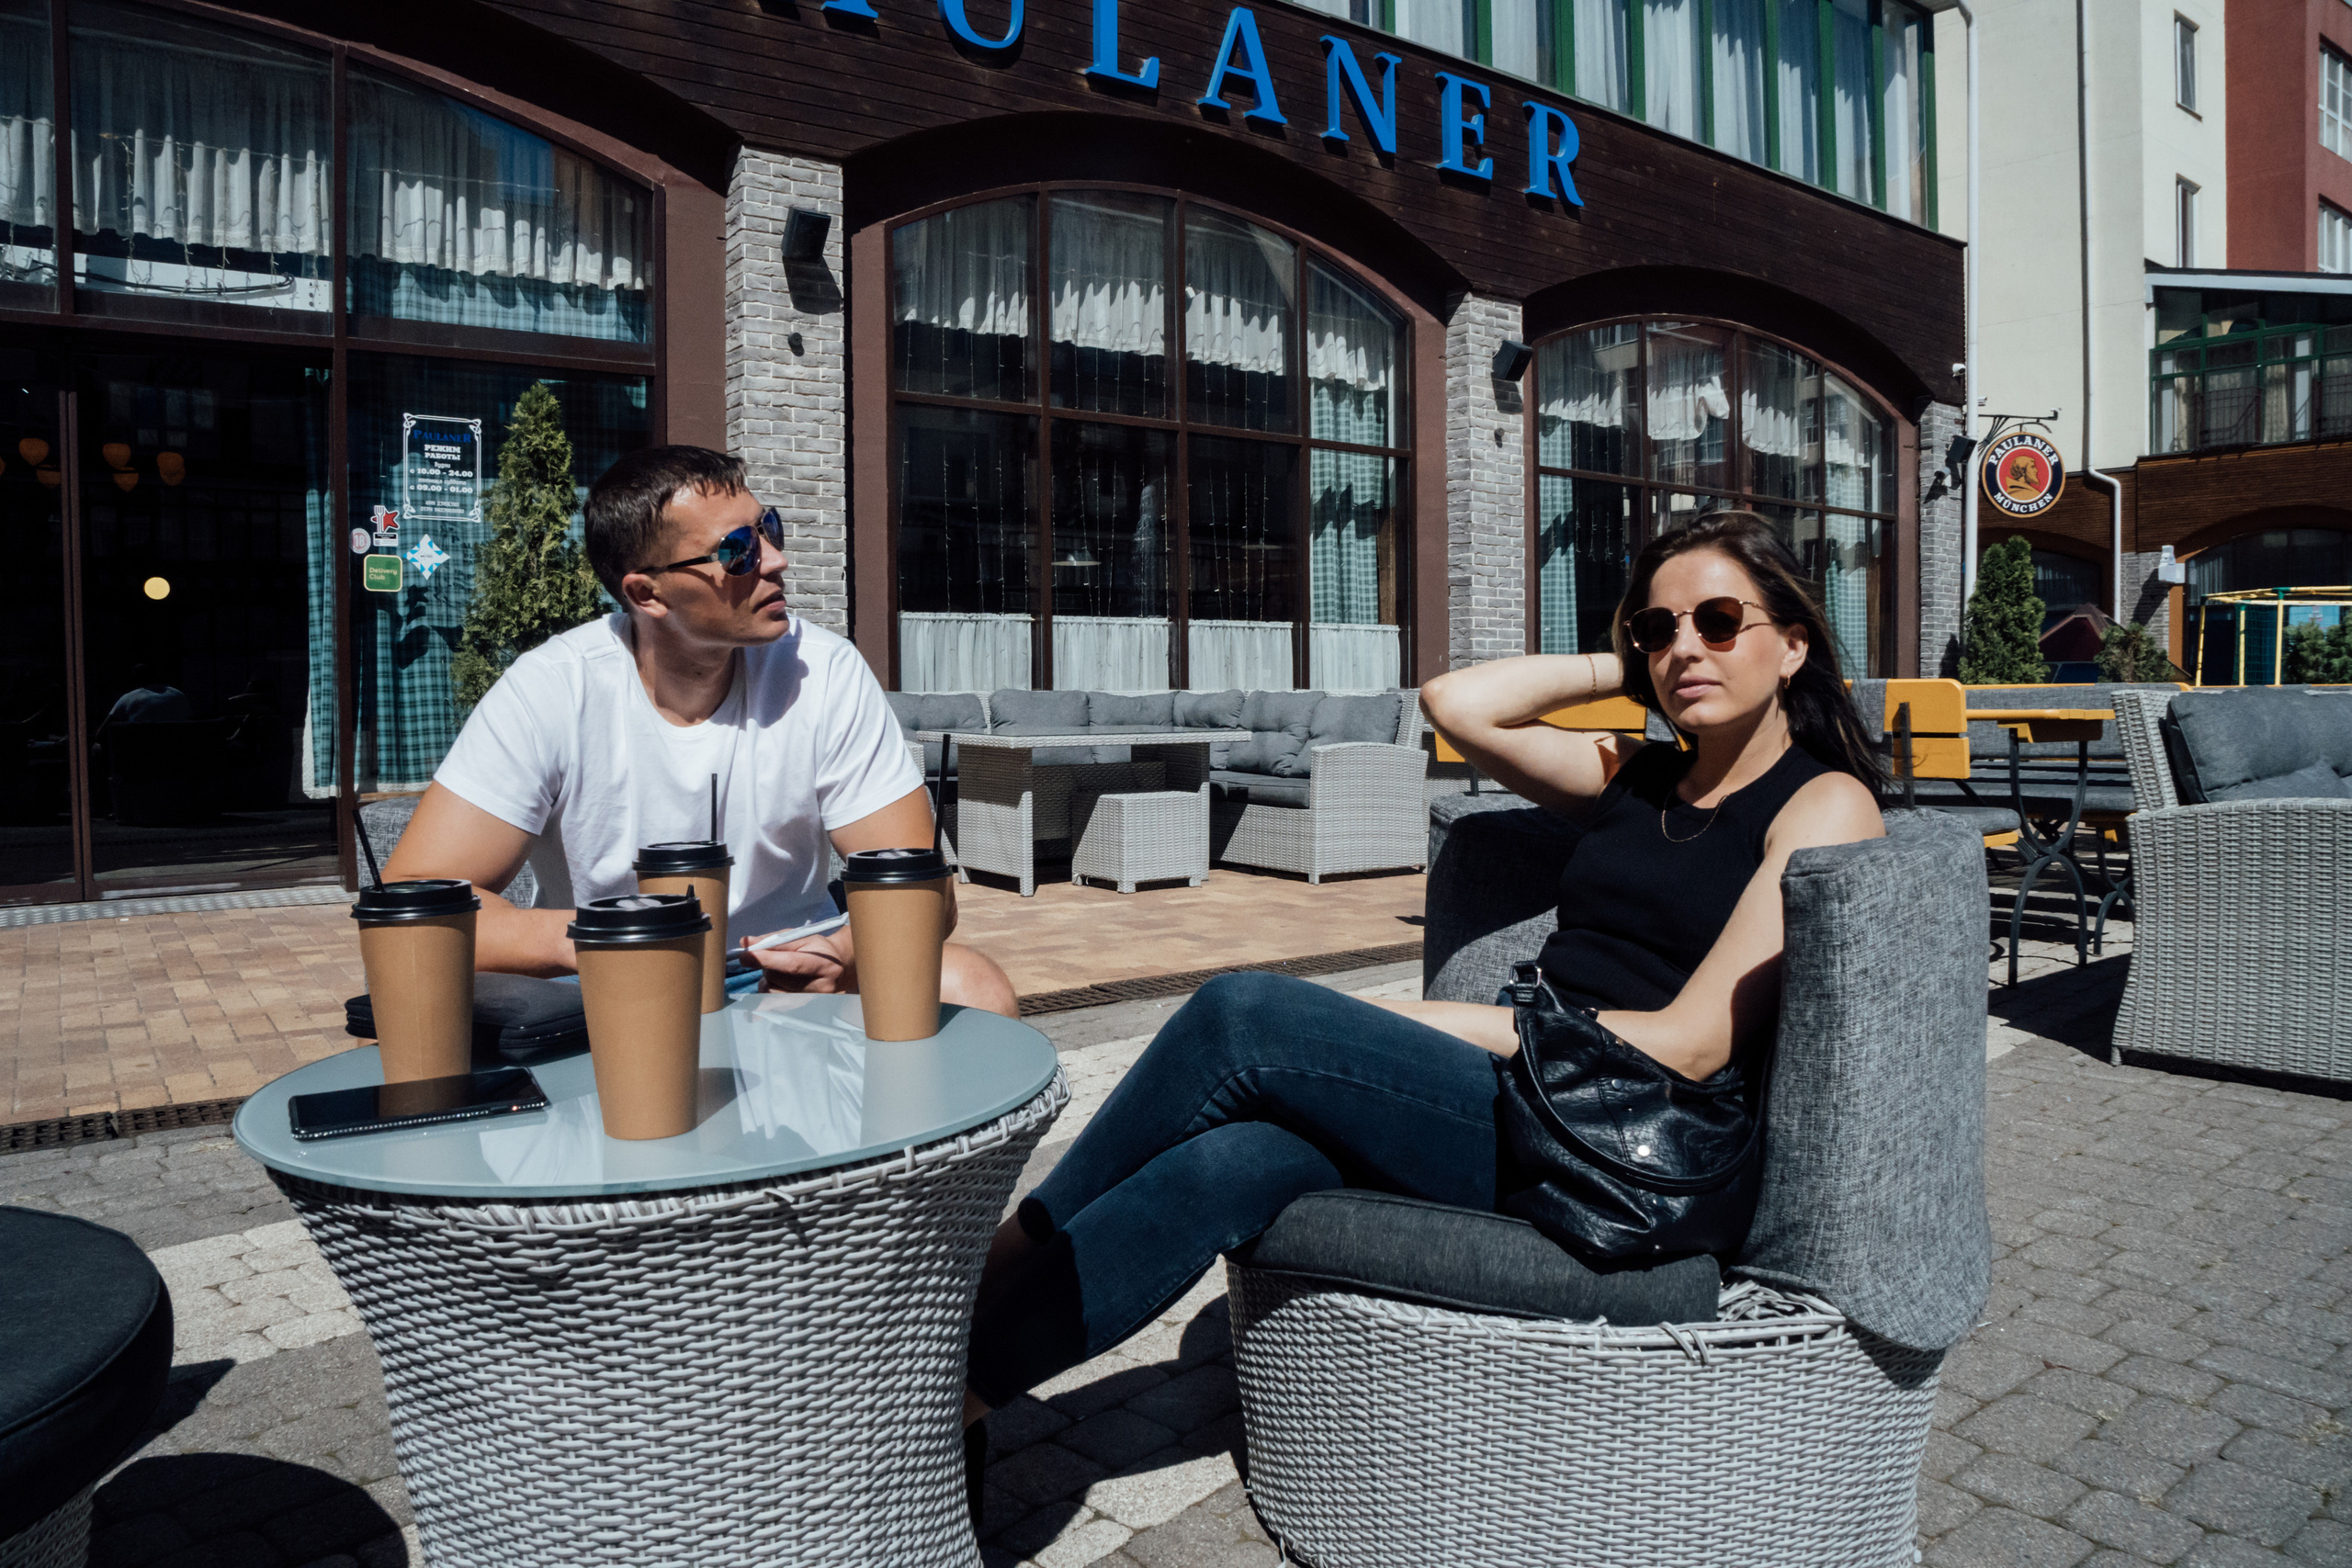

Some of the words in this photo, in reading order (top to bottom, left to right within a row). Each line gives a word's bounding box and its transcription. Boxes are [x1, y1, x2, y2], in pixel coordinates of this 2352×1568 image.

[424, 444, 461, 454] РЕЖИМ
[1987, 435, 2060, 466] PAULANER
[424, 452, 461, 461] РАБОТЫ
[416, 468, 441, 476] 10.00
[448, 469, 474, 478] 24.00
[416, 484, 442, 492] 09.00
[1993, 491, 2053, 513] MÜNCHEN
[369, 567, 398, 576] Delivery
